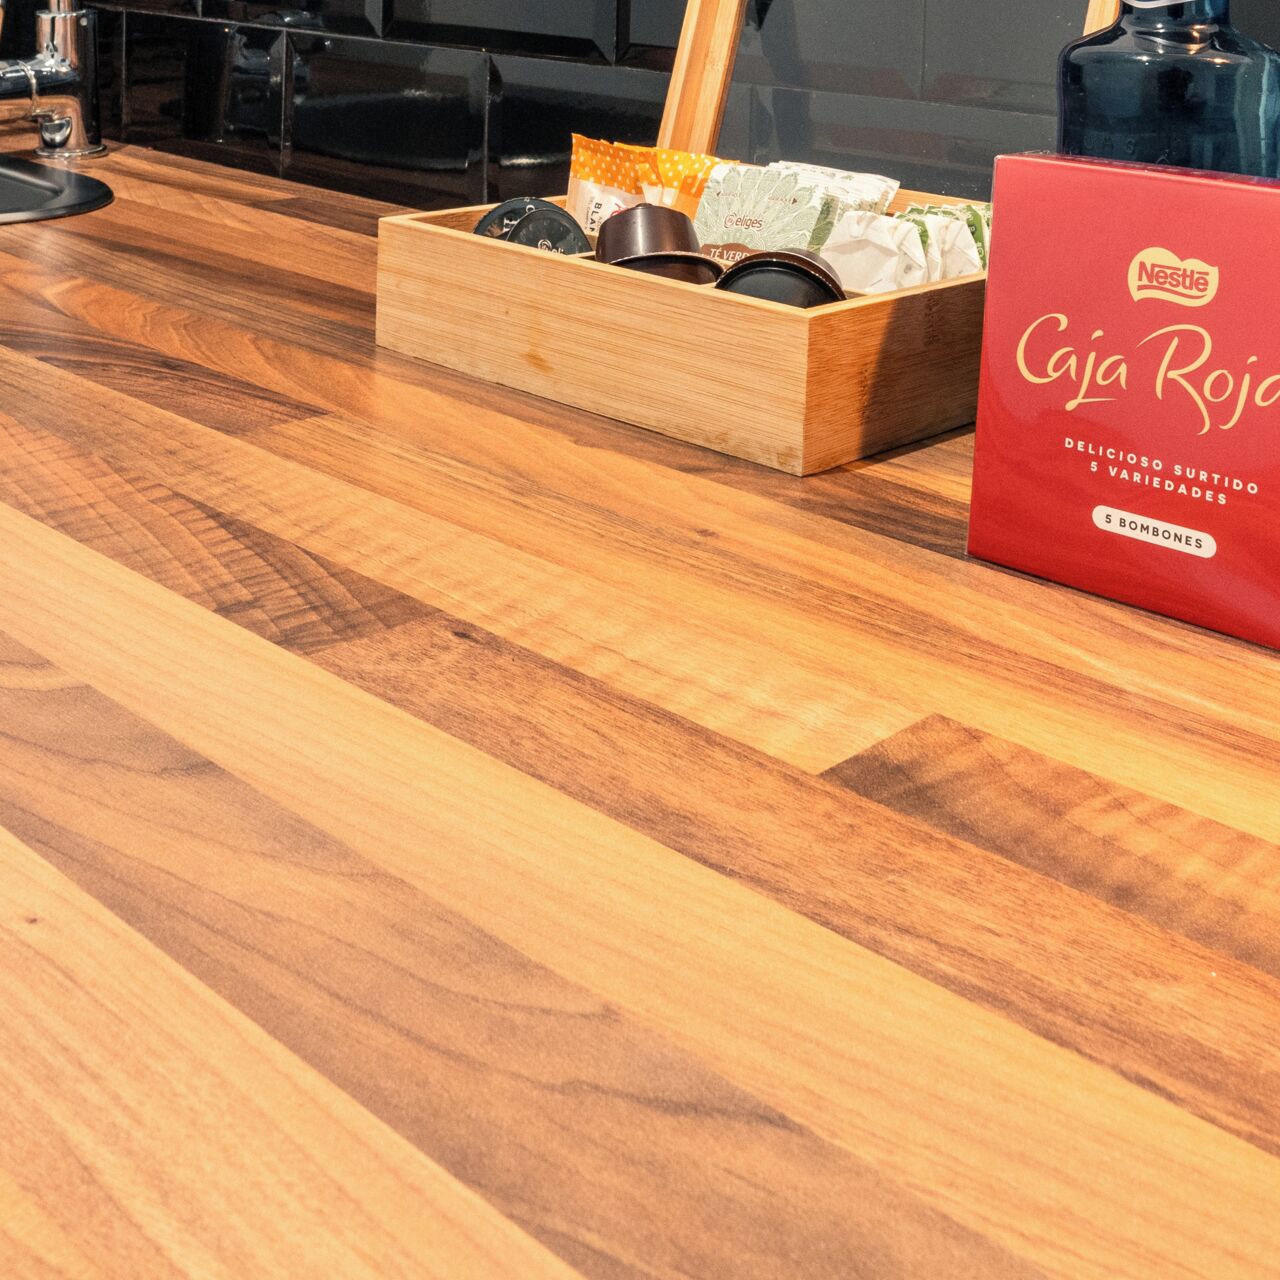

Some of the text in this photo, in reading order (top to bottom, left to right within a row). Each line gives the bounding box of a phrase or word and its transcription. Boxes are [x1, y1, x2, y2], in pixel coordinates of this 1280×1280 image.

[710, 247, 722, 259] TÉ
[1016, 313, 1128, 412] Caja
[1064, 437, 1259, 495] DELICIOSO SURTIDO
[1090, 461, 1228, 505] 5 VARIEDADES
[1104, 514, 1204, 549] 5 BOMBONES
